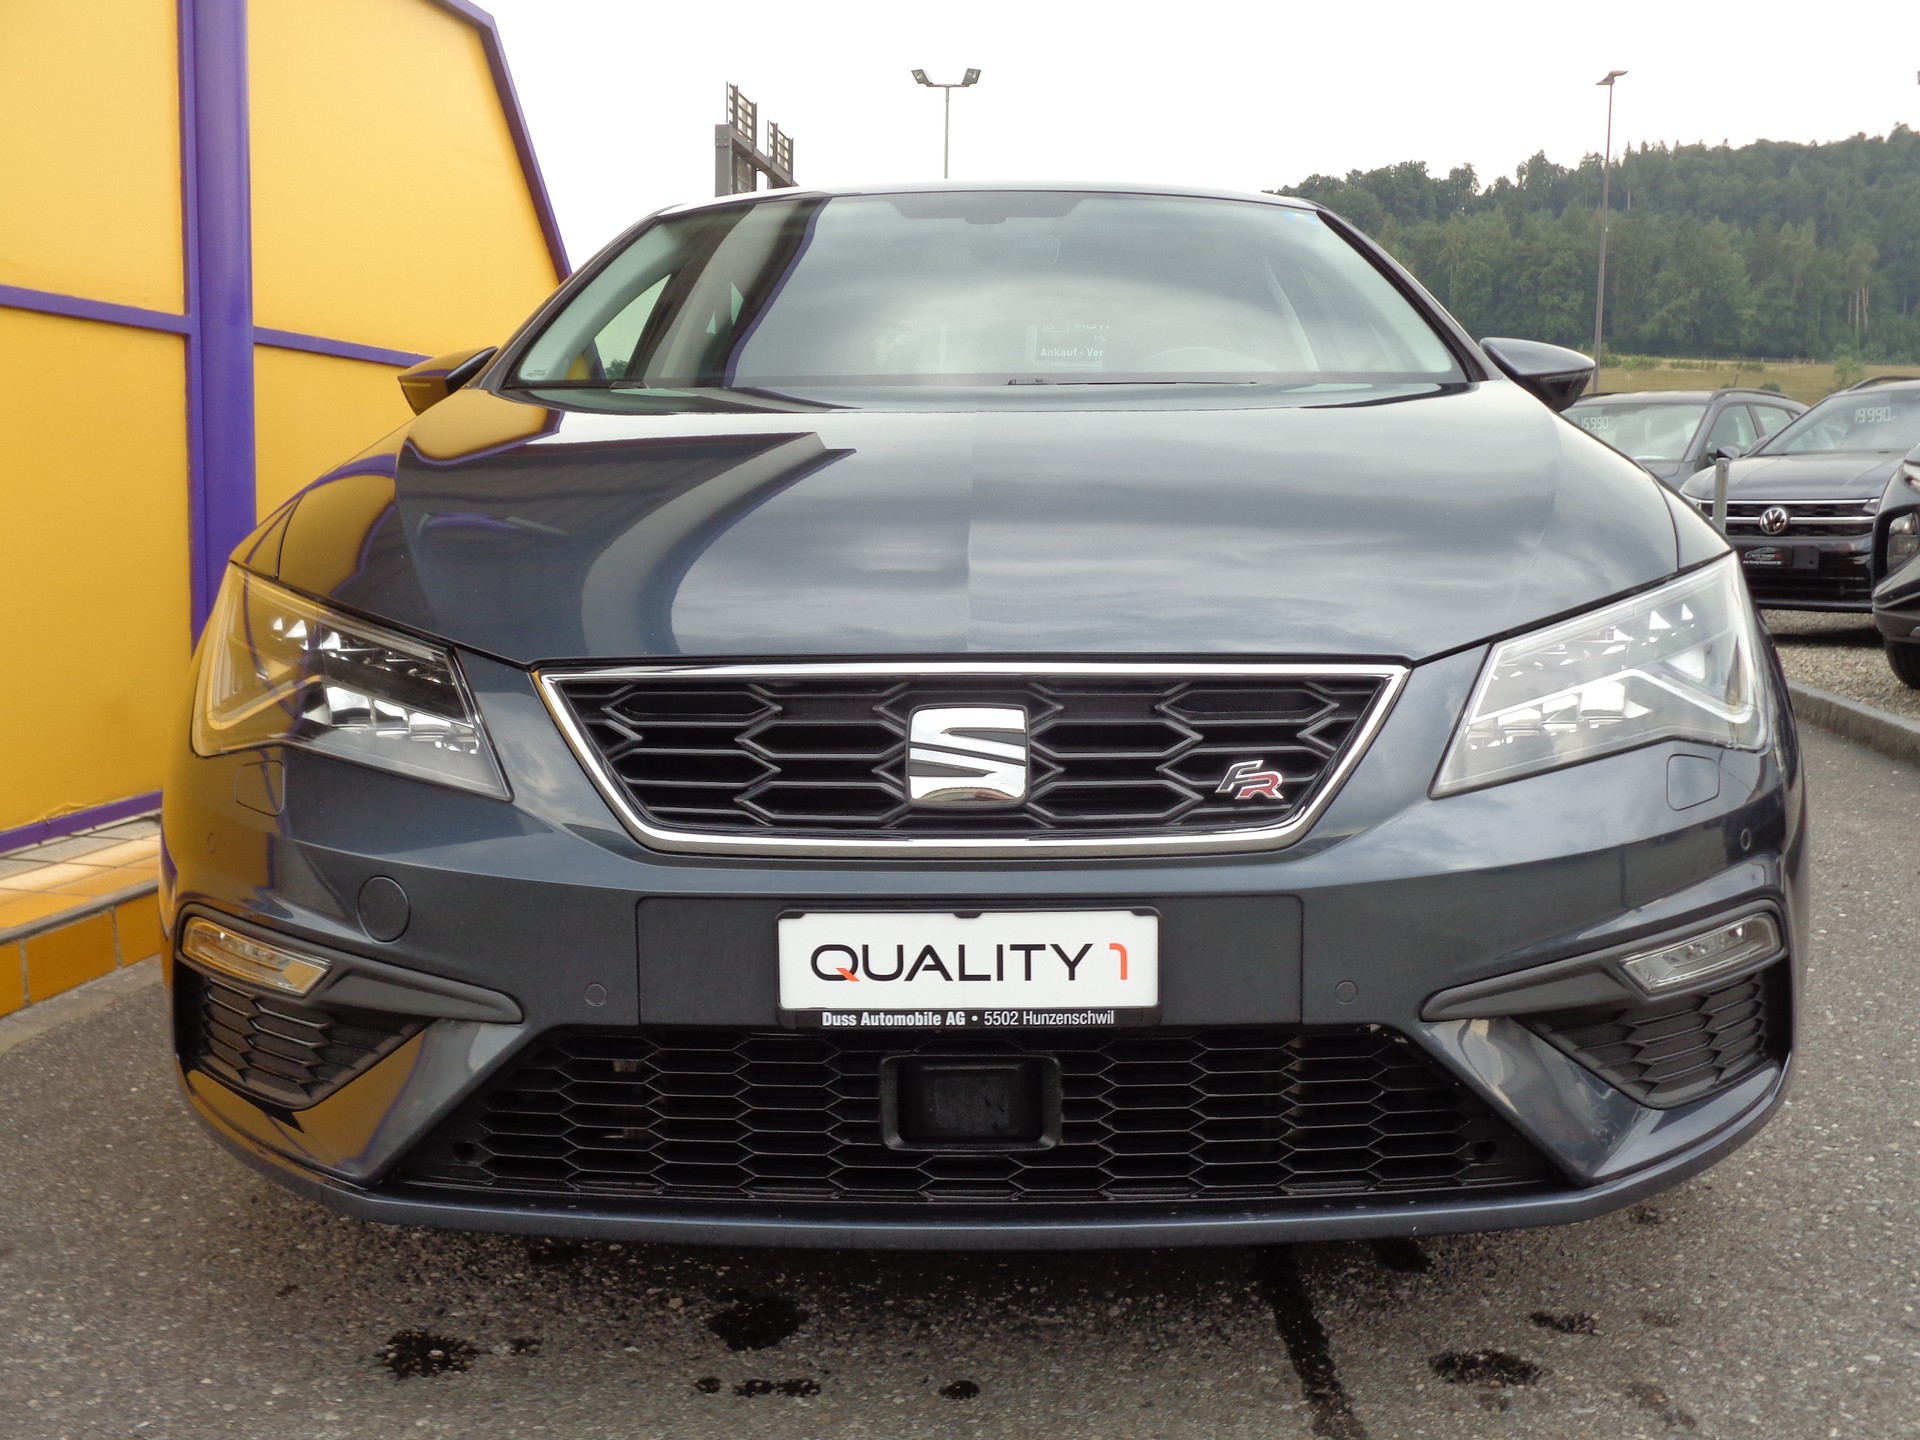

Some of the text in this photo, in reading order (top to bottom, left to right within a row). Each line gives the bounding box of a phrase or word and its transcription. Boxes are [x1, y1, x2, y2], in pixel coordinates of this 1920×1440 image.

[1040, 347, 1077, 357] Ankauf
[1215, 760, 1284, 799] FR
[810, 943, 1127, 982] QUALITY 1
[822, 1009, 1115, 1026] Duss Automobile AG 5502 Hunzenschwil
